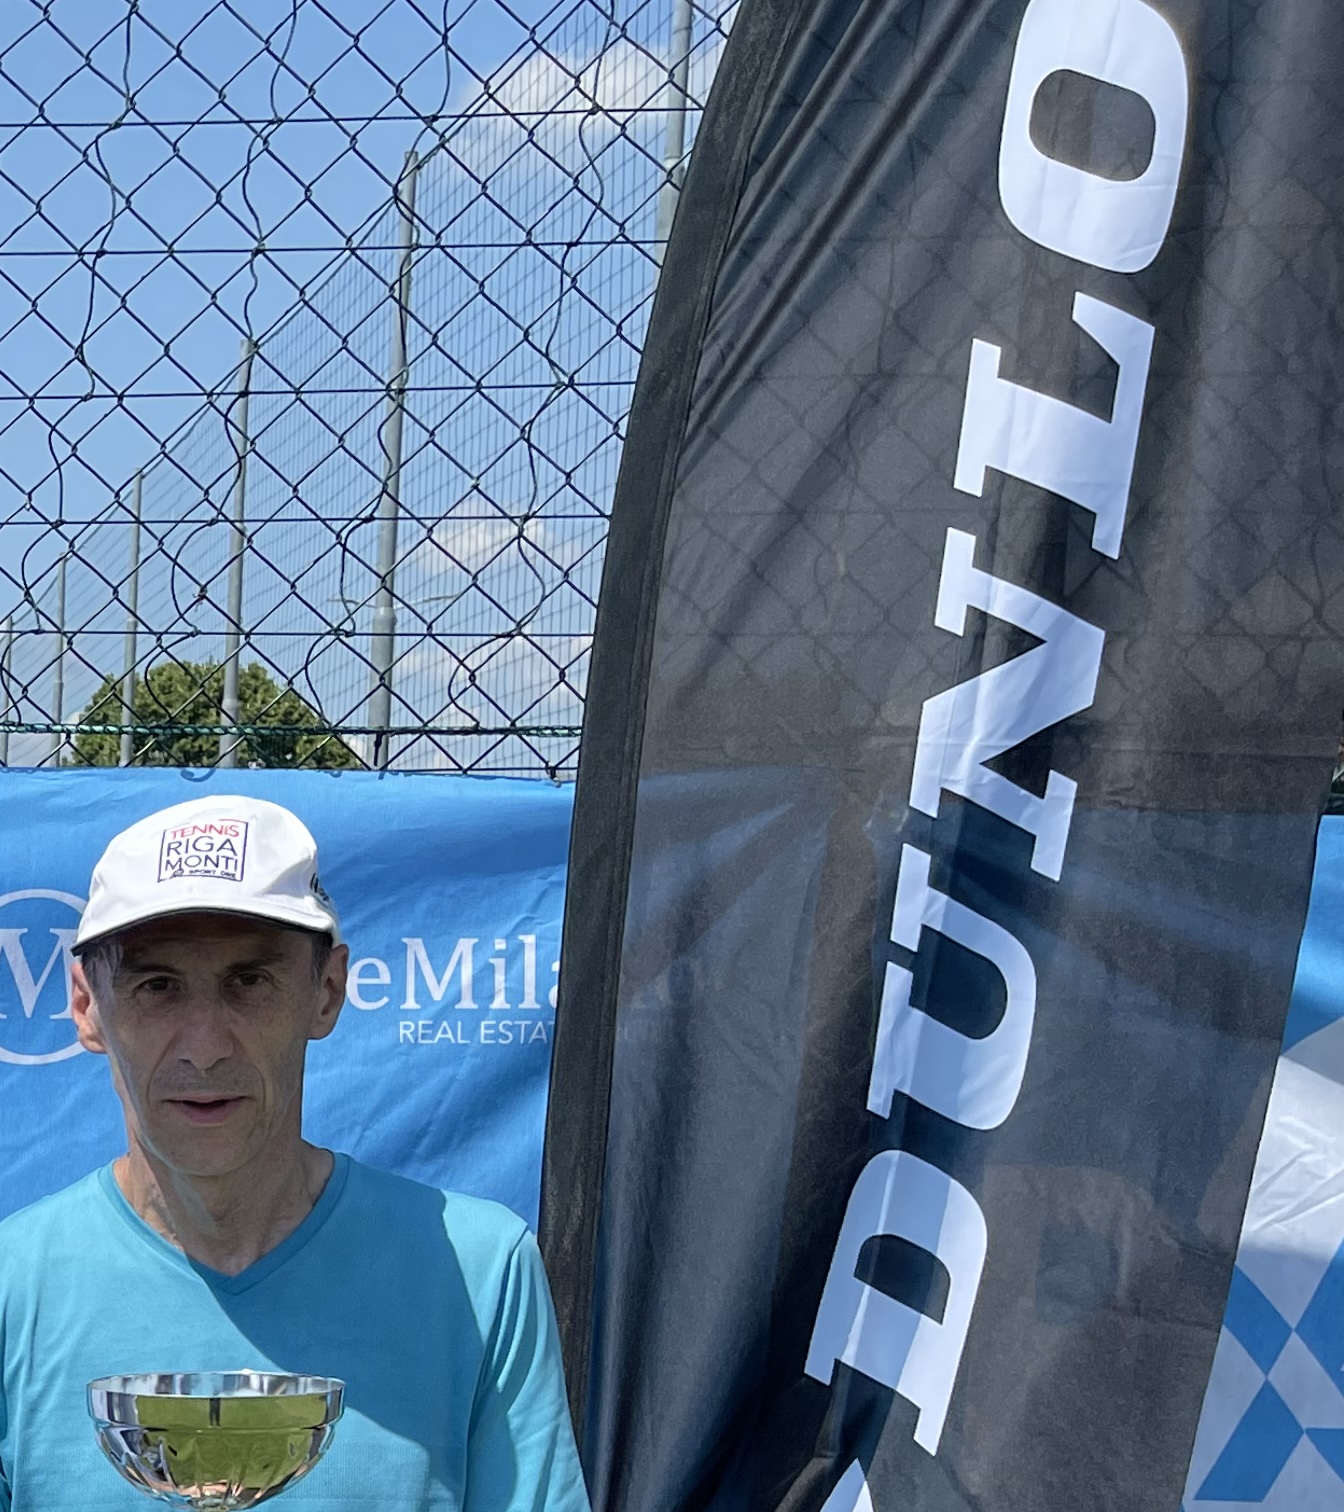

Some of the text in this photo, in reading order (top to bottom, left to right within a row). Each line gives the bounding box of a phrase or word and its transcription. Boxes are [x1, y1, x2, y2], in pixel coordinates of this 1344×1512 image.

[170, 824, 240, 840] TENNIS
[166, 835, 238, 858] RIGA
[164, 854, 238, 872] MONTI
[345, 934, 560, 1011] eMil
[399, 1020, 470, 1045] REAL
